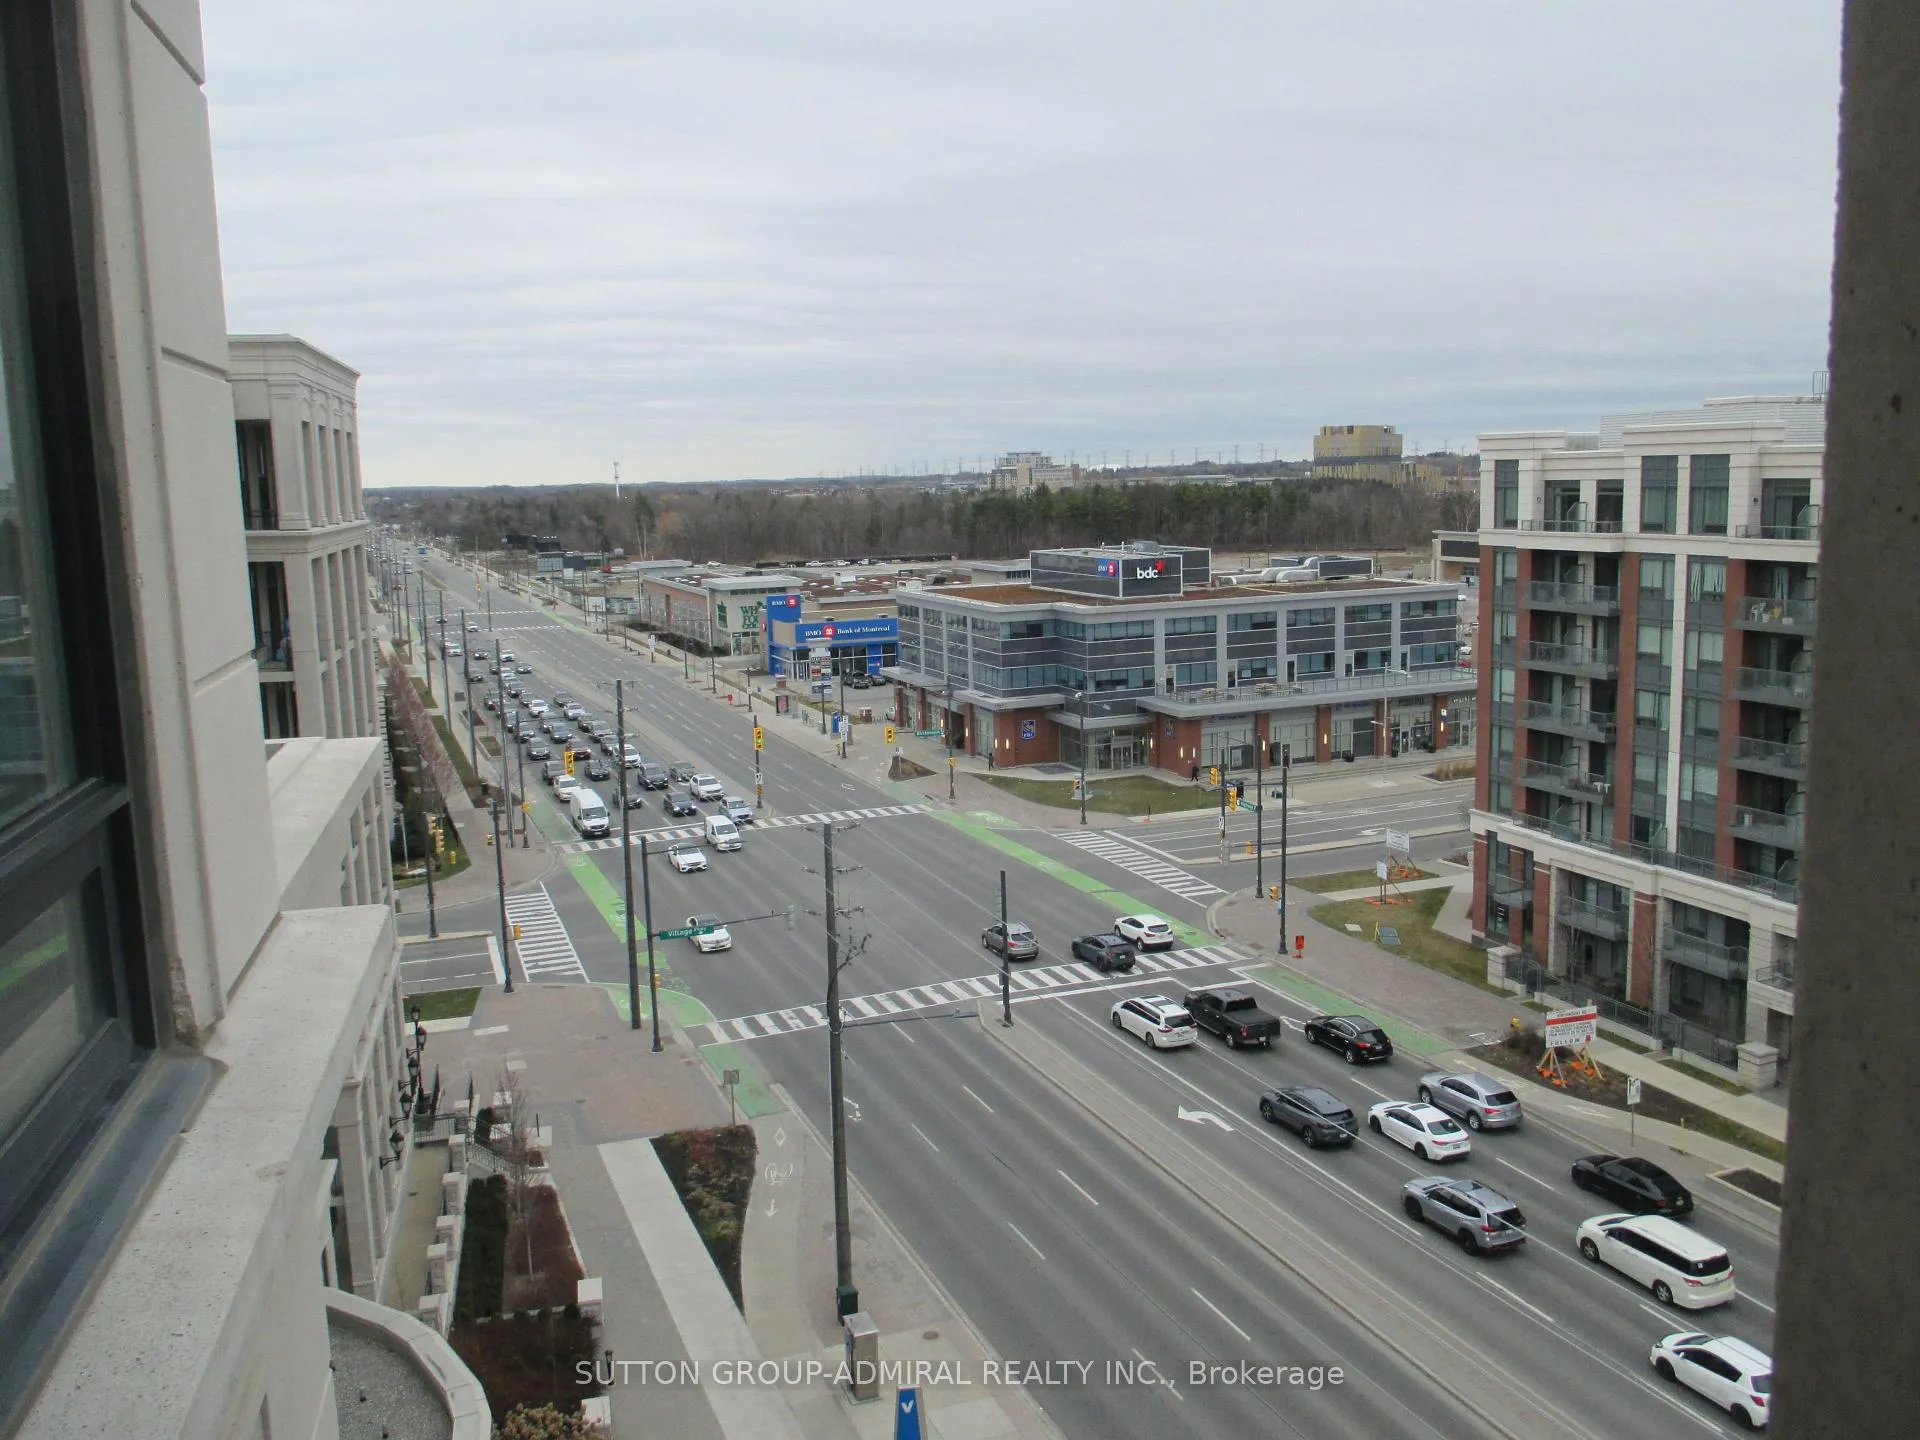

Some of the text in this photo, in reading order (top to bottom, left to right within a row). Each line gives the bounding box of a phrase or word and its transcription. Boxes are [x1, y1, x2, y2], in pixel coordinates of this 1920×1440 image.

[1136, 566, 1159, 579] bdc
[837, 627, 853, 635] Bank
[861, 625, 890, 633] Montreal
[667, 929, 692, 937] Village
